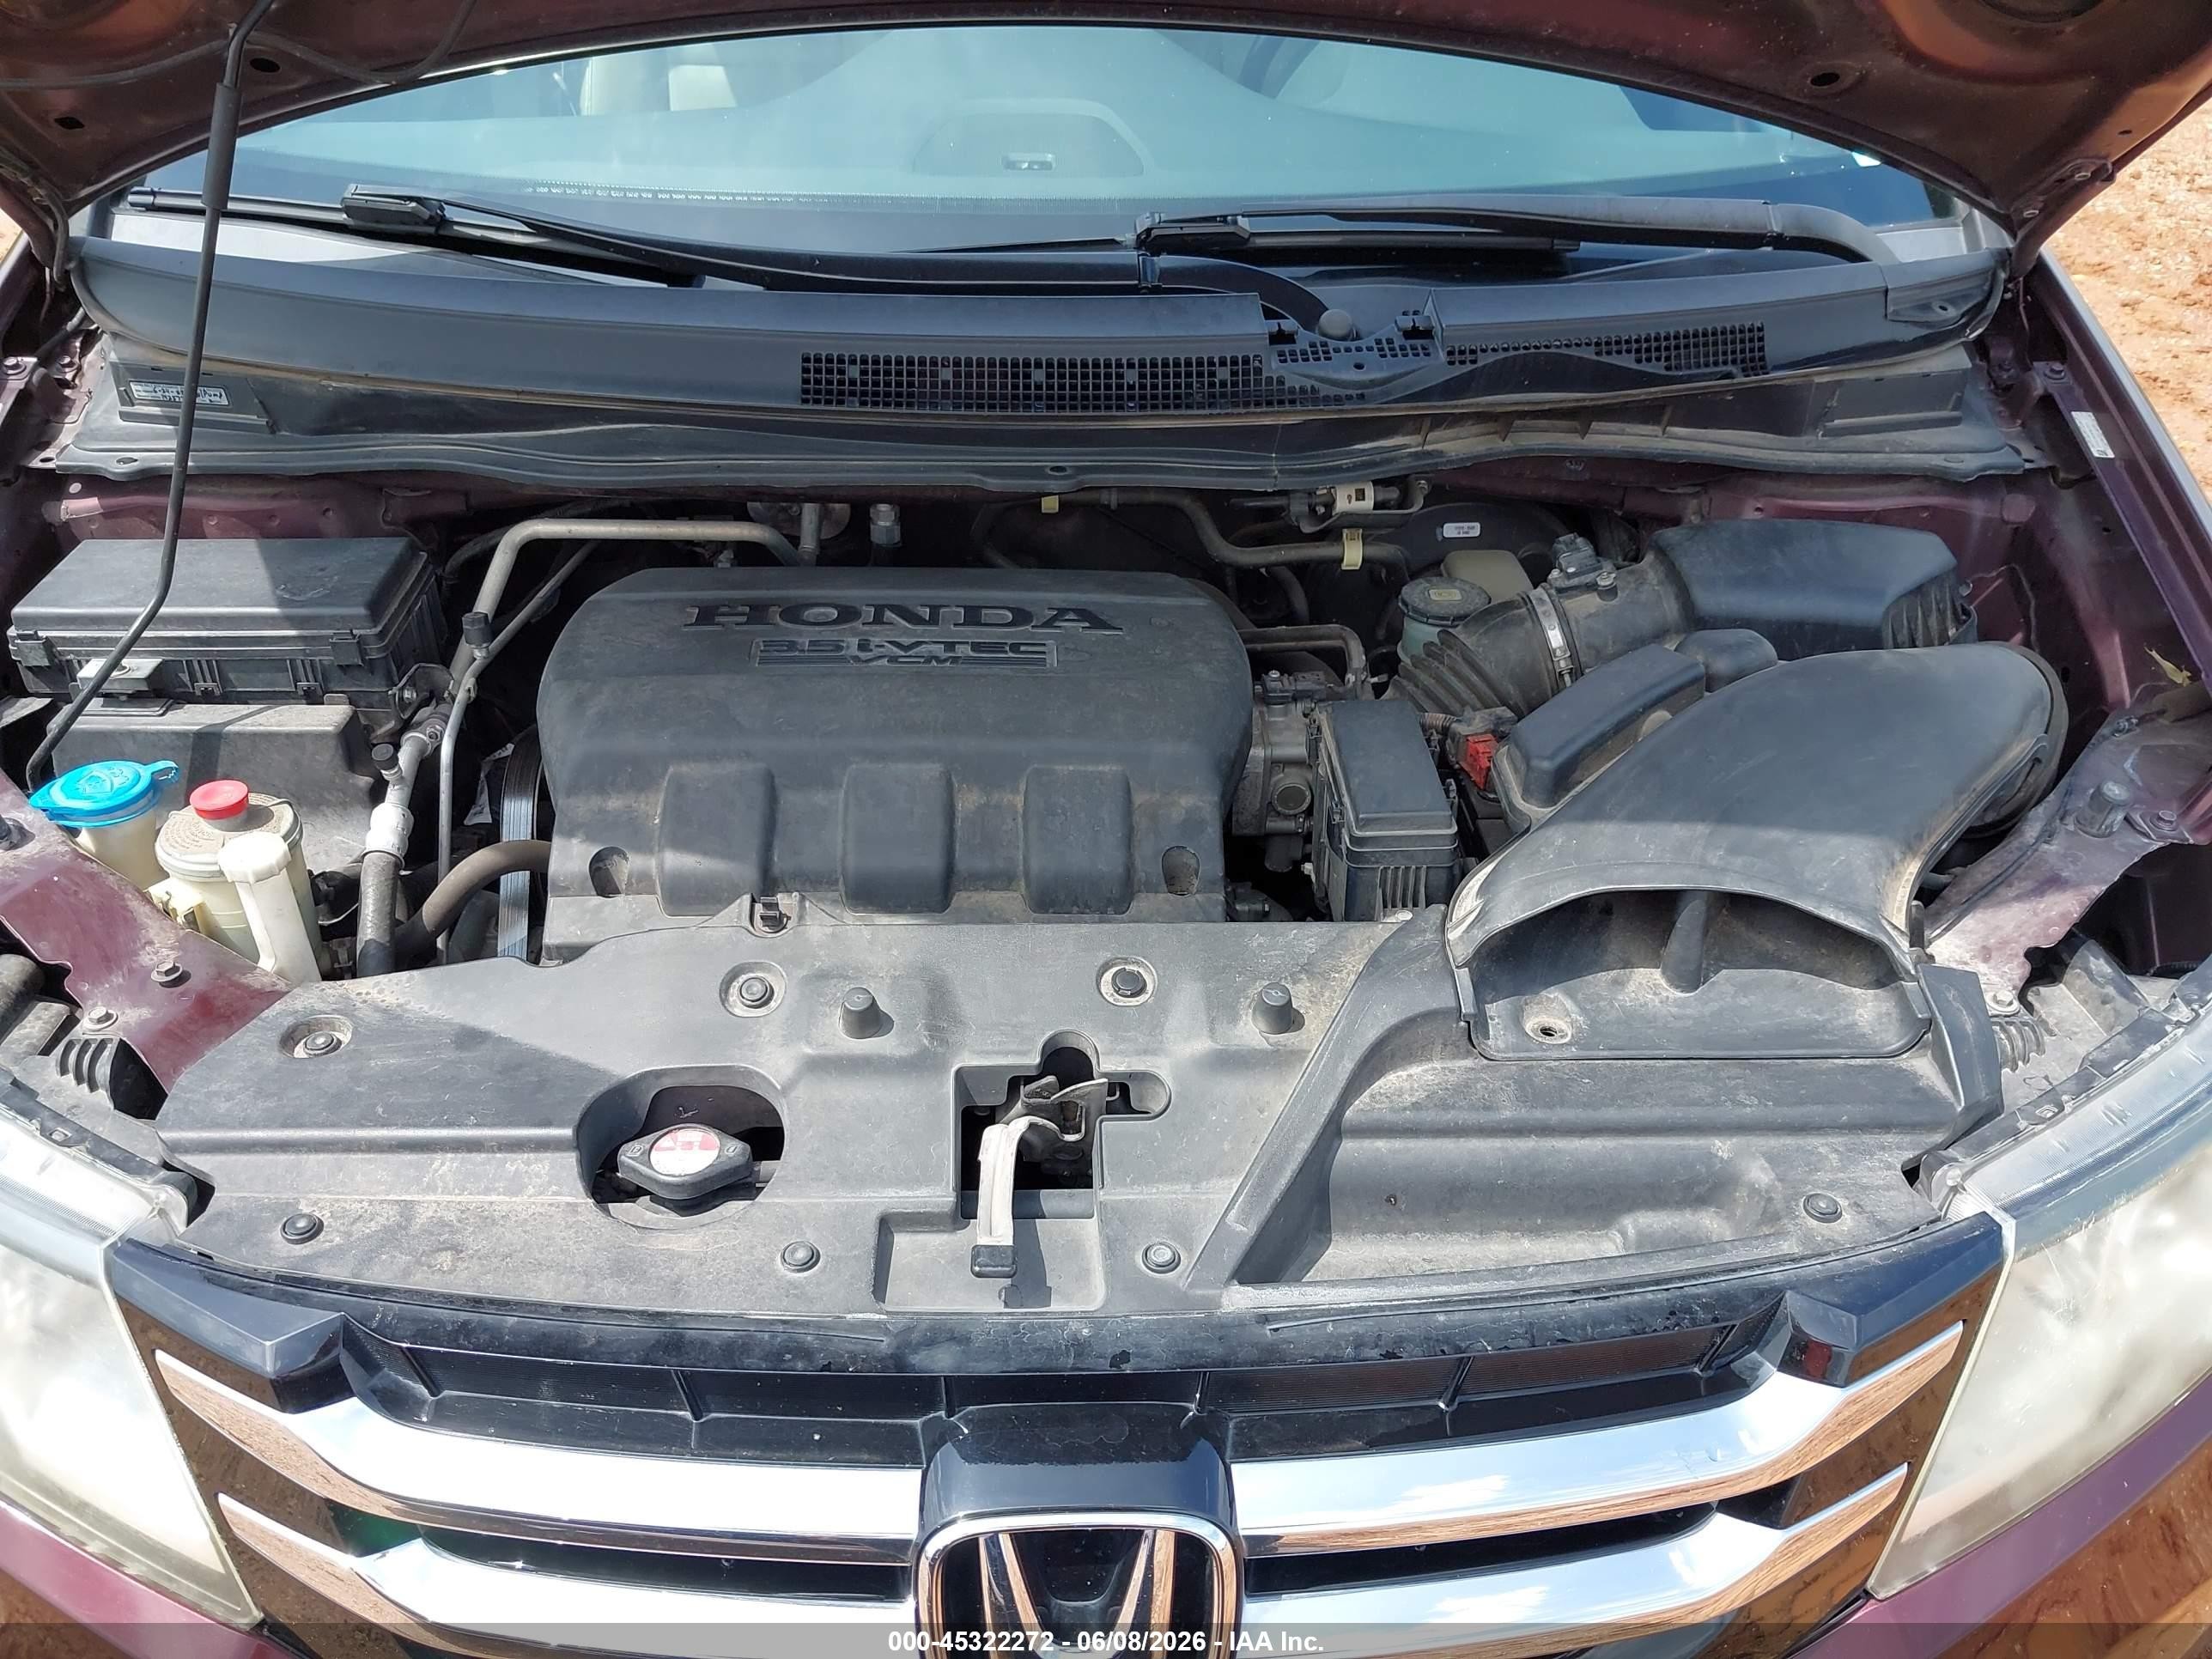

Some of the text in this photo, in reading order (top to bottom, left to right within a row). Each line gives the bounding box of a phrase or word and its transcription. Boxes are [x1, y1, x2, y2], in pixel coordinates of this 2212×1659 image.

[682, 603, 1123, 634] HONDA
[760, 637, 1047, 658] 3.5 i-VTEC
[849, 653, 963, 667] VCM
